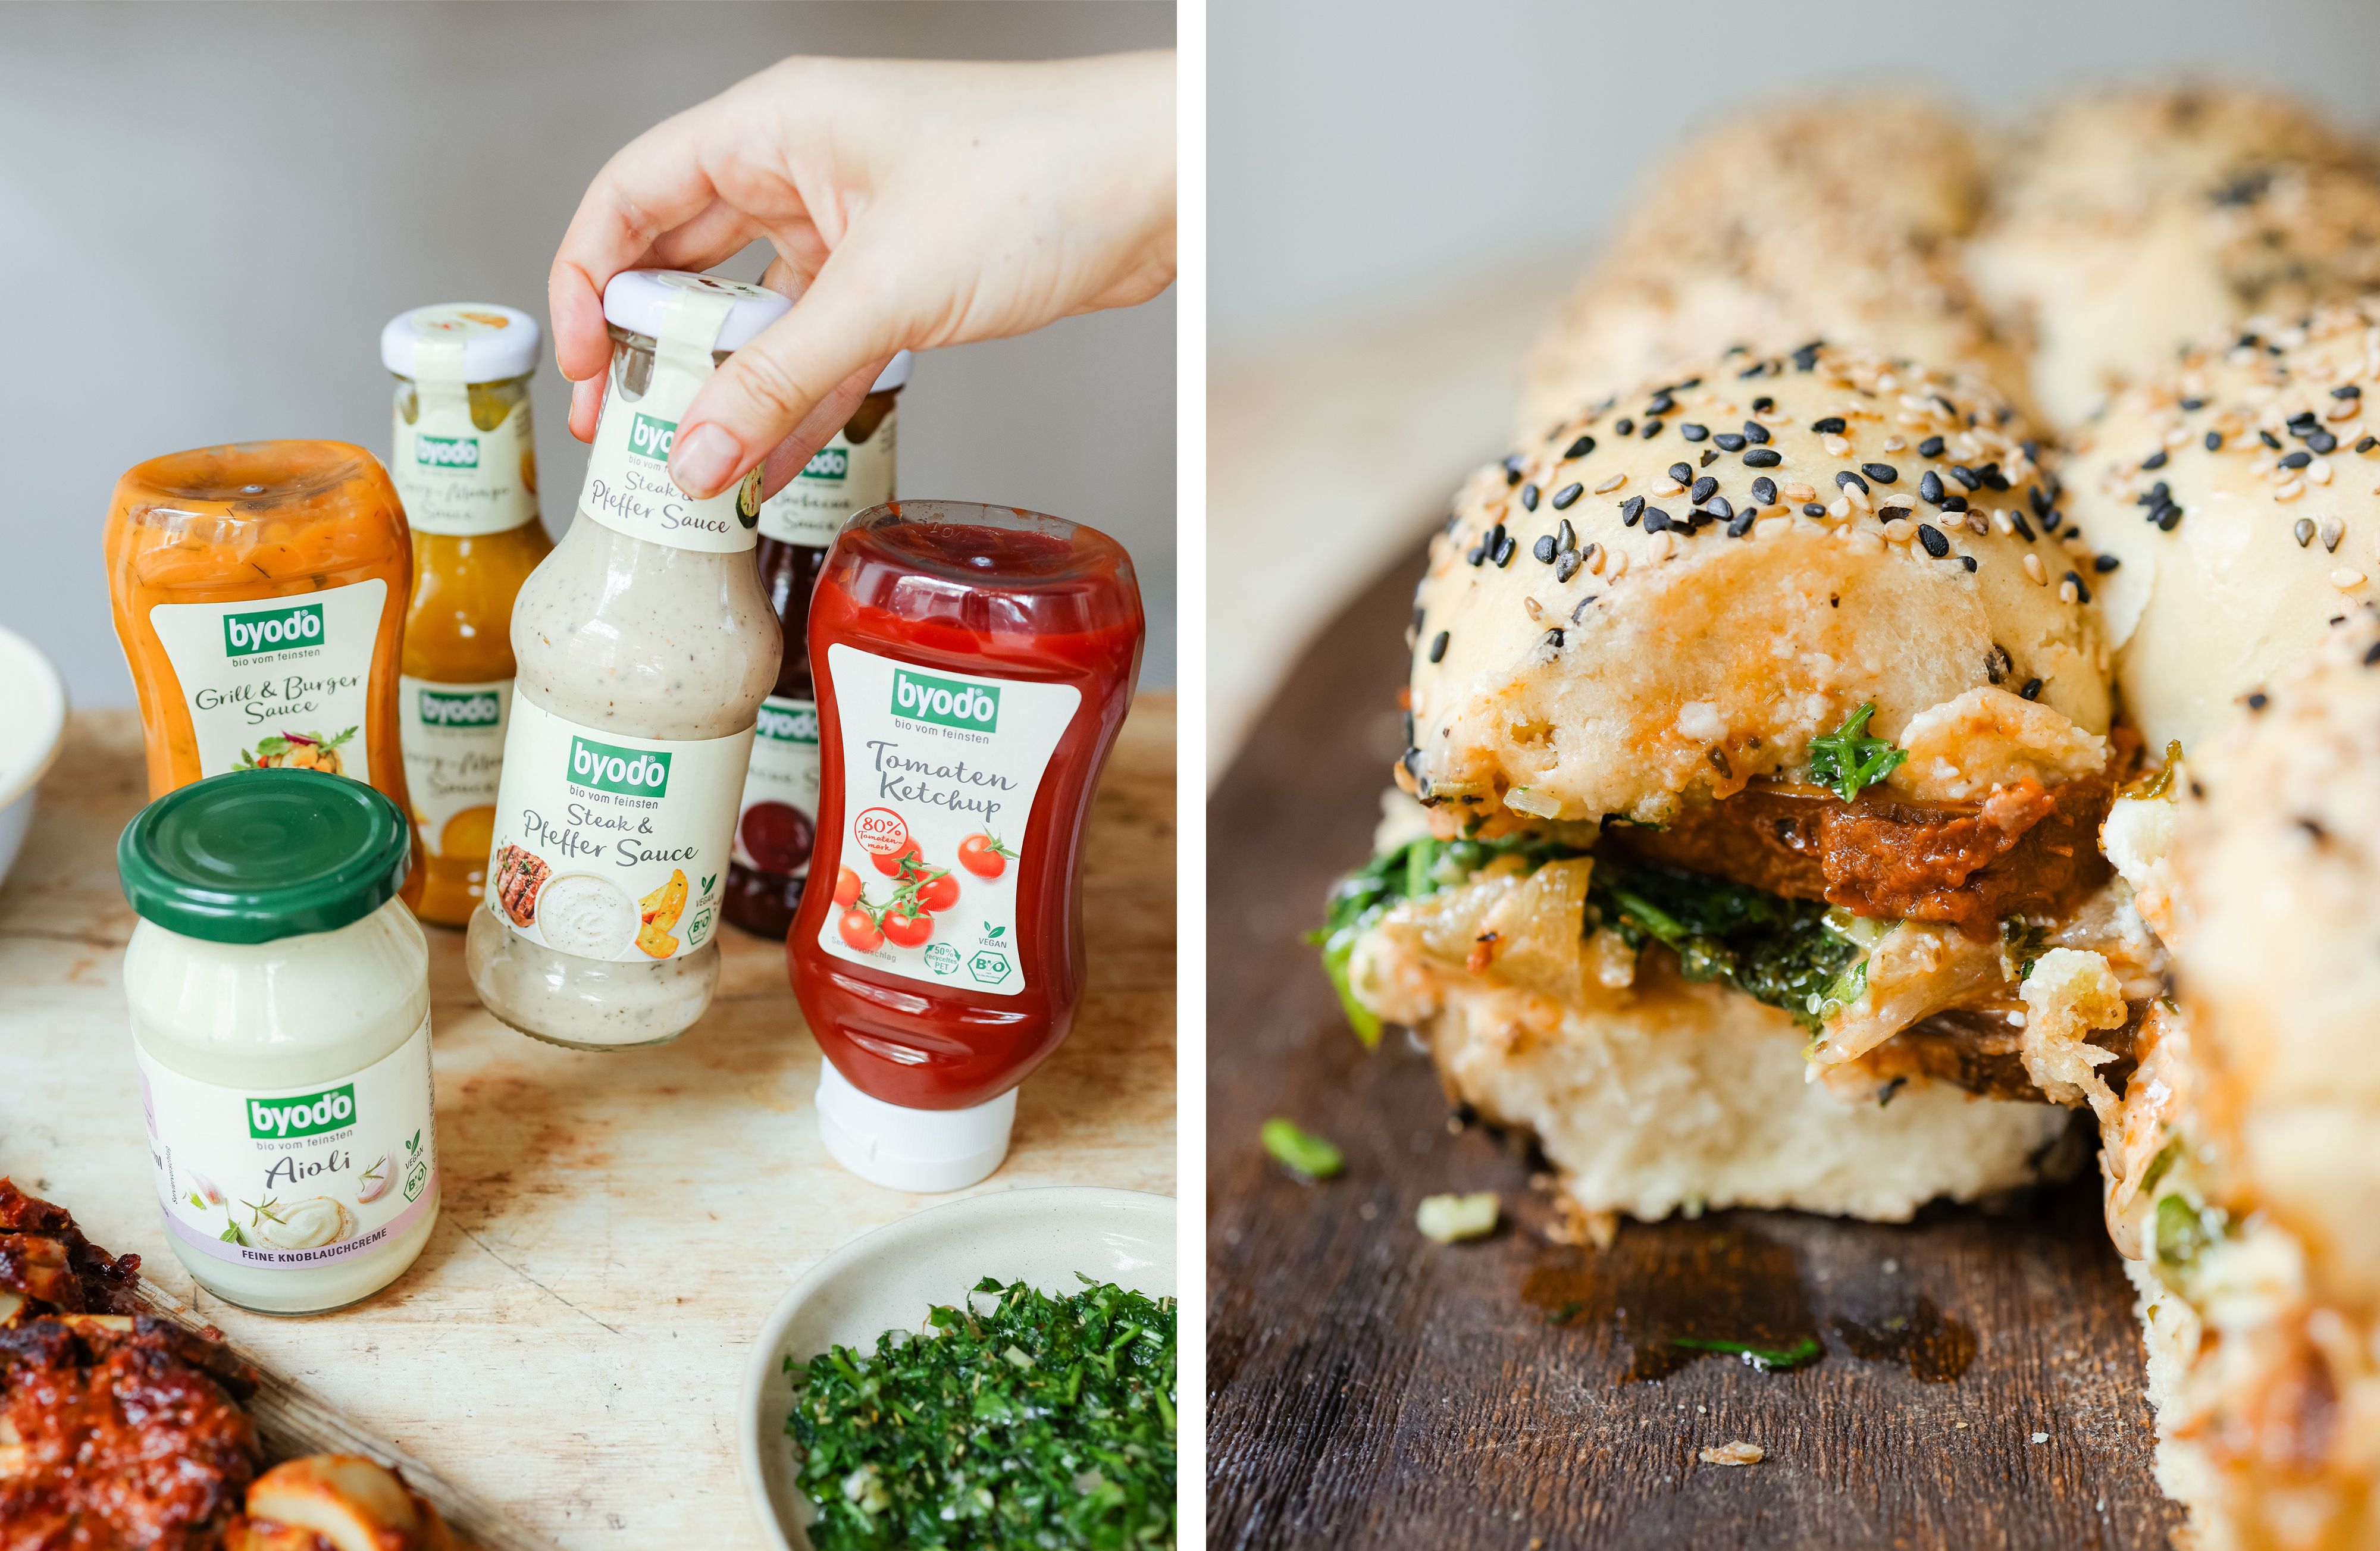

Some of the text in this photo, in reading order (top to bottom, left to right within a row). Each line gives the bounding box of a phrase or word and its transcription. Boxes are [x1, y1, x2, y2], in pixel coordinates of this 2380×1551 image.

[634, 416, 674, 455] byo
[629, 455, 641, 465] bio
[644, 460, 661, 471] vom
[806, 450, 846, 475] odo
[625, 471, 677, 496] Steak
[592, 480, 730, 533] Pfeffer Sauce
[228, 610, 321, 651] byodo
[232, 648, 320, 668] bio vom feinsten
[195, 674, 361, 710] Grill & Burger
[897, 673, 995, 722] byodo
[245, 699, 319, 725] Sauce
[895, 718, 989, 744] bio vom feinsten
[574, 741, 665, 787] byodo
[866, 740, 1018, 791] Tomaten
[569, 785, 658, 809] bio vom feinsten
[880, 770, 1001, 823] Ketchup
[567, 803, 653, 834] Steak &
[863, 817, 901, 836] 80%
[523, 810, 699, 867] Pfeffer Sauce
[858, 831, 903, 844] Tomaten-
[868, 843, 892, 851] mark
[696, 893, 714, 907] VEGAN
[832, 936, 897, 963] Serviervorschlag
[979, 938, 1007, 948] VEGAN
[935, 962, 949, 971] PET
[250, 1092, 352, 1137] byodo
[256, 1130, 353, 1151] bio vom feinsten
[265, 1150, 350, 1189] Aioli
[405, 1145, 423, 1170] VEGAN
[165, 1146, 178, 1205] Serviervorschlag
[242, 1227, 388, 1262] FEINE KNOBLAUCHCREME
